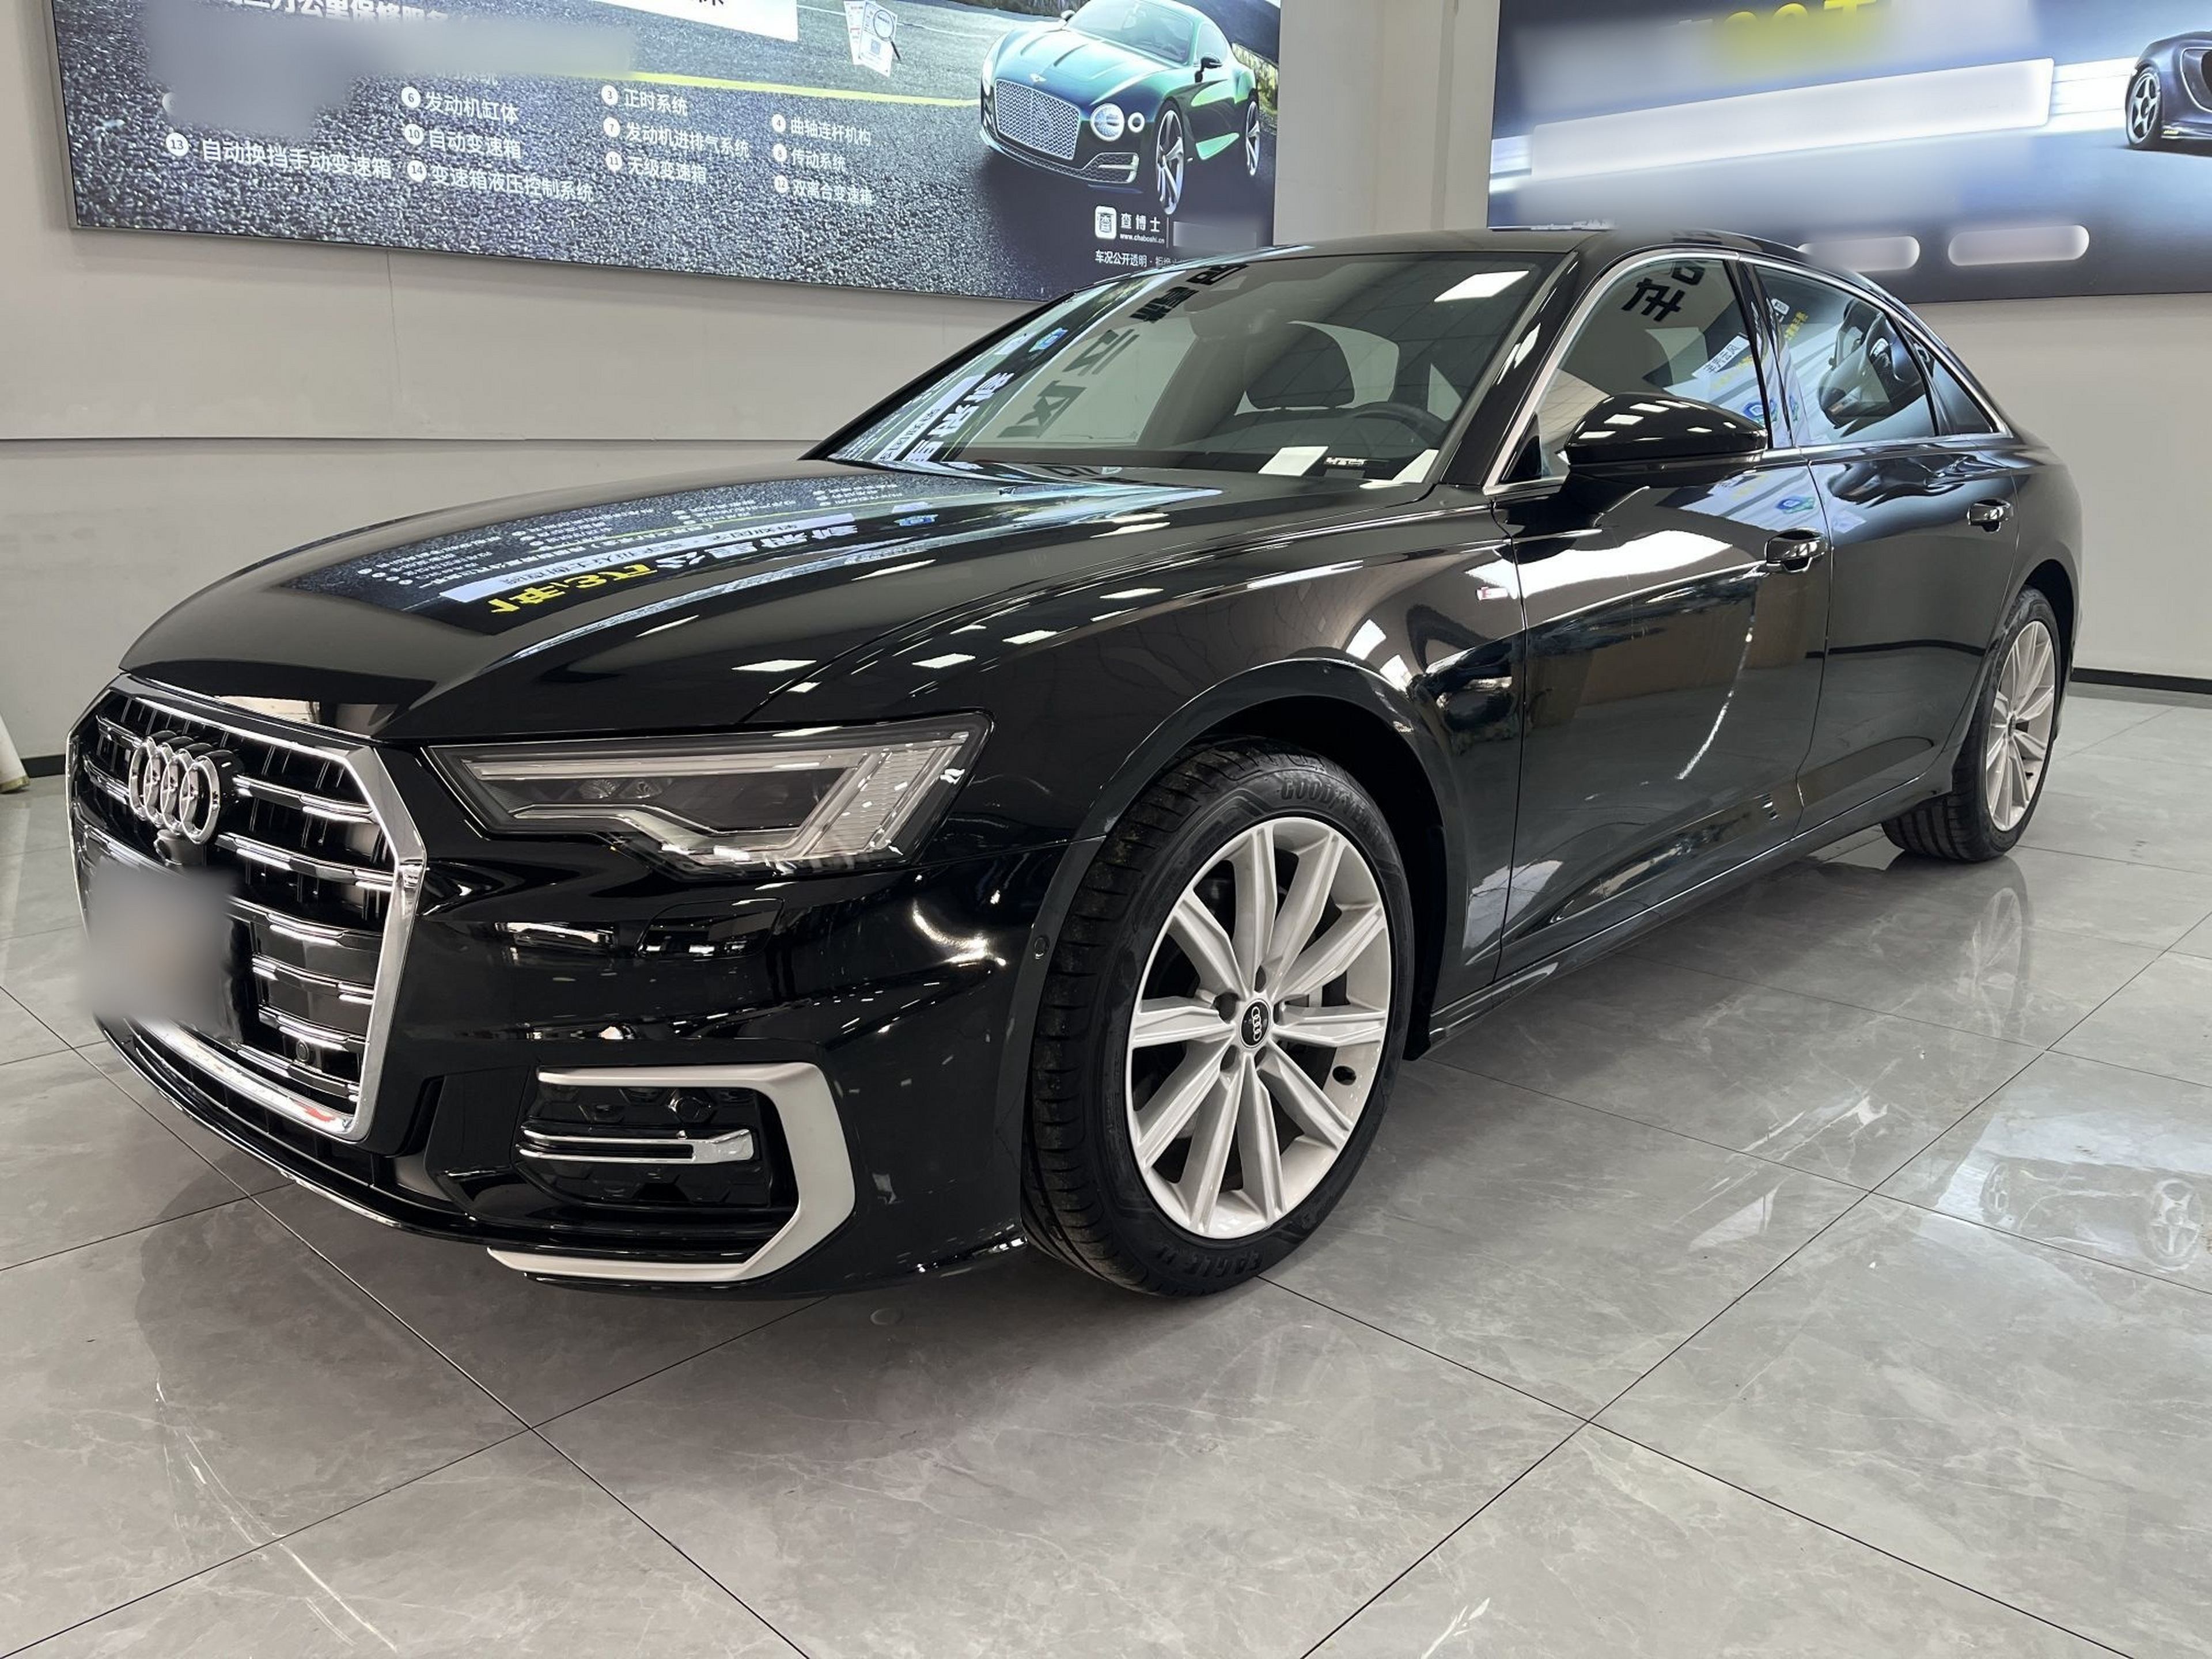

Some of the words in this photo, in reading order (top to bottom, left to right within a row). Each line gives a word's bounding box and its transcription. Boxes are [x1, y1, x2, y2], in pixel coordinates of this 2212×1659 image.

[425, 91, 519, 124] 发动机缸体
[624, 88, 687, 116] 正时系统
[429, 127, 521, 159] 自动变速箱
[626, 122, 749, 158] 发动机进排气系统
[790, 118, 871, 146] 曲轴连杆机构
[202, 138, 392, 180] 自动换挡手动变速箱
[628, 154, 707, 184] 无级变速箱
[791, 147, 846, 171] 传动系统
[430, 165, 593, 202] 变速箱液压控制系统
[792, 179, 873, 206] 双离合变速箱
[1121, 213, 1160, 232] 查博士
[1120, 233, 1165, 244] www.chaboshi.cn
[1095, 249, 1147, 267] 车况公开透明
